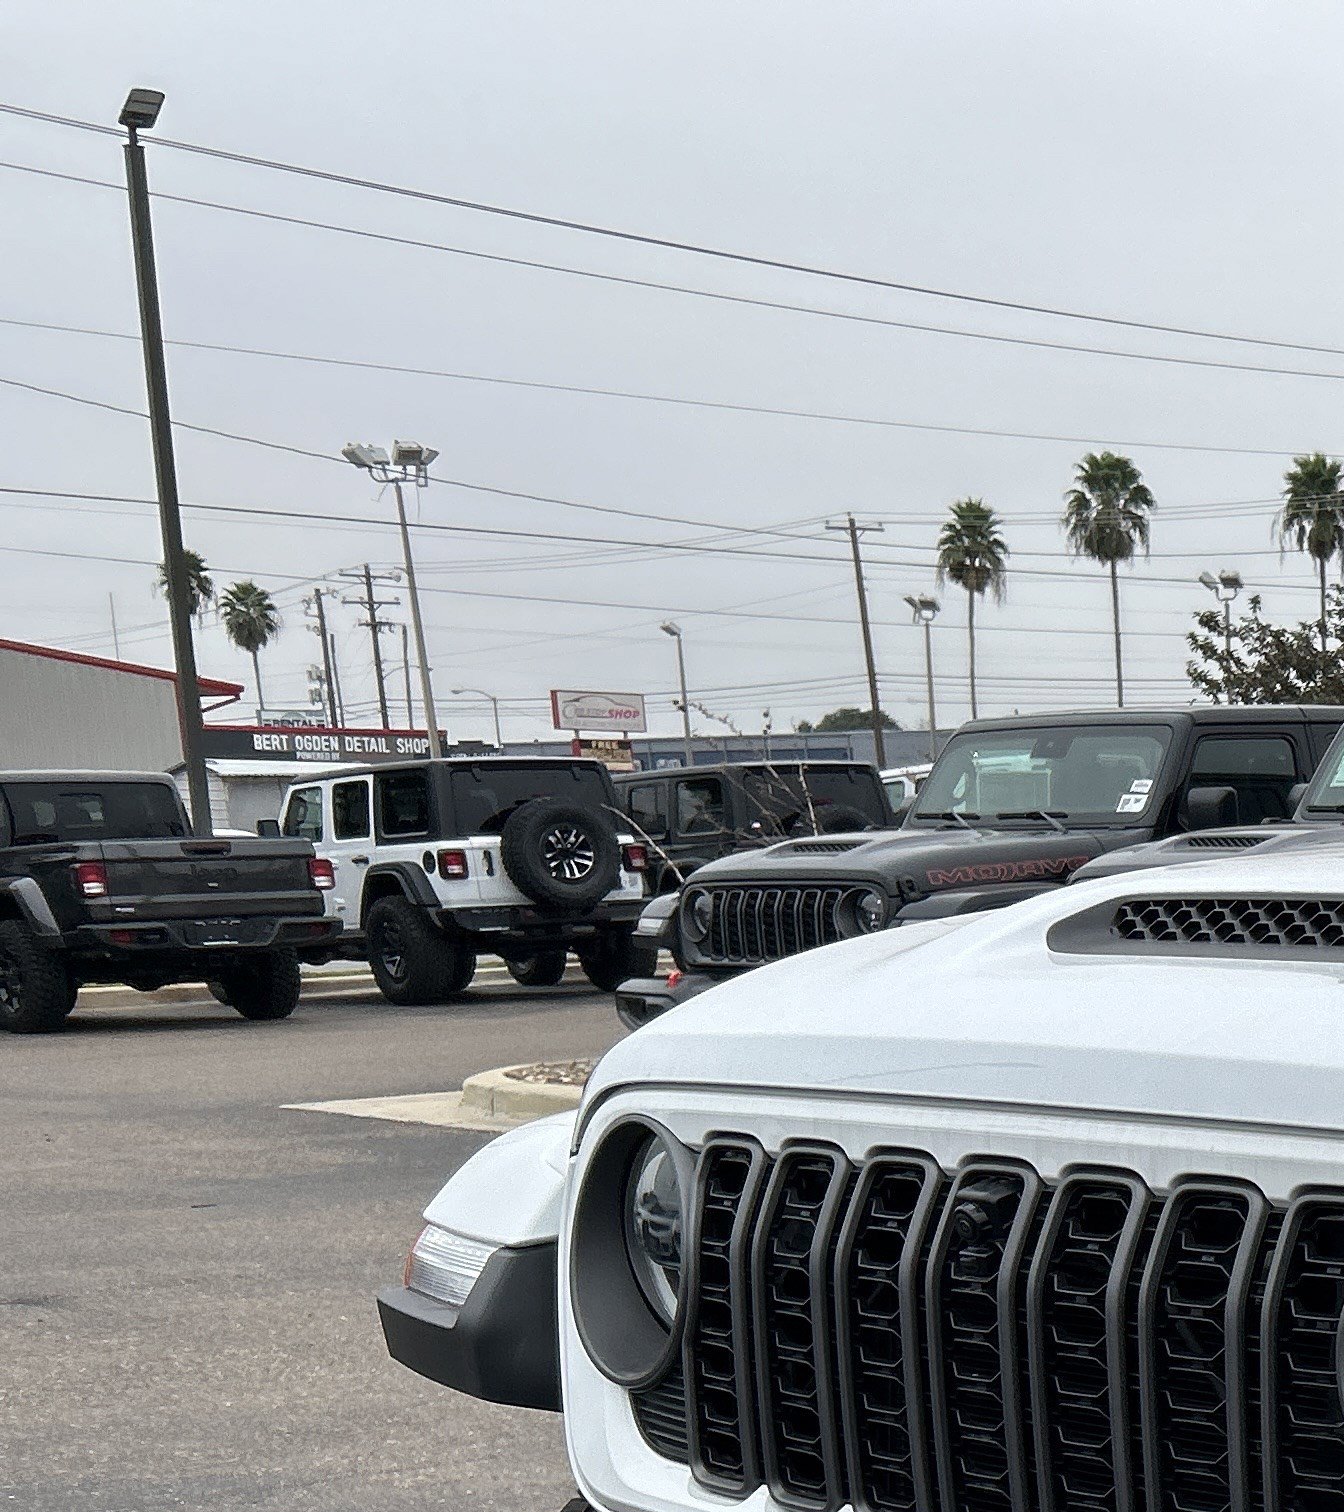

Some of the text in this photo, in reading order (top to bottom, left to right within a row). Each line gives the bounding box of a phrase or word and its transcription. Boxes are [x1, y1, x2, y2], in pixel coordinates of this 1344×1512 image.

[252, 733, 430, 754] BERT OGDEN DETAIL SHOP
